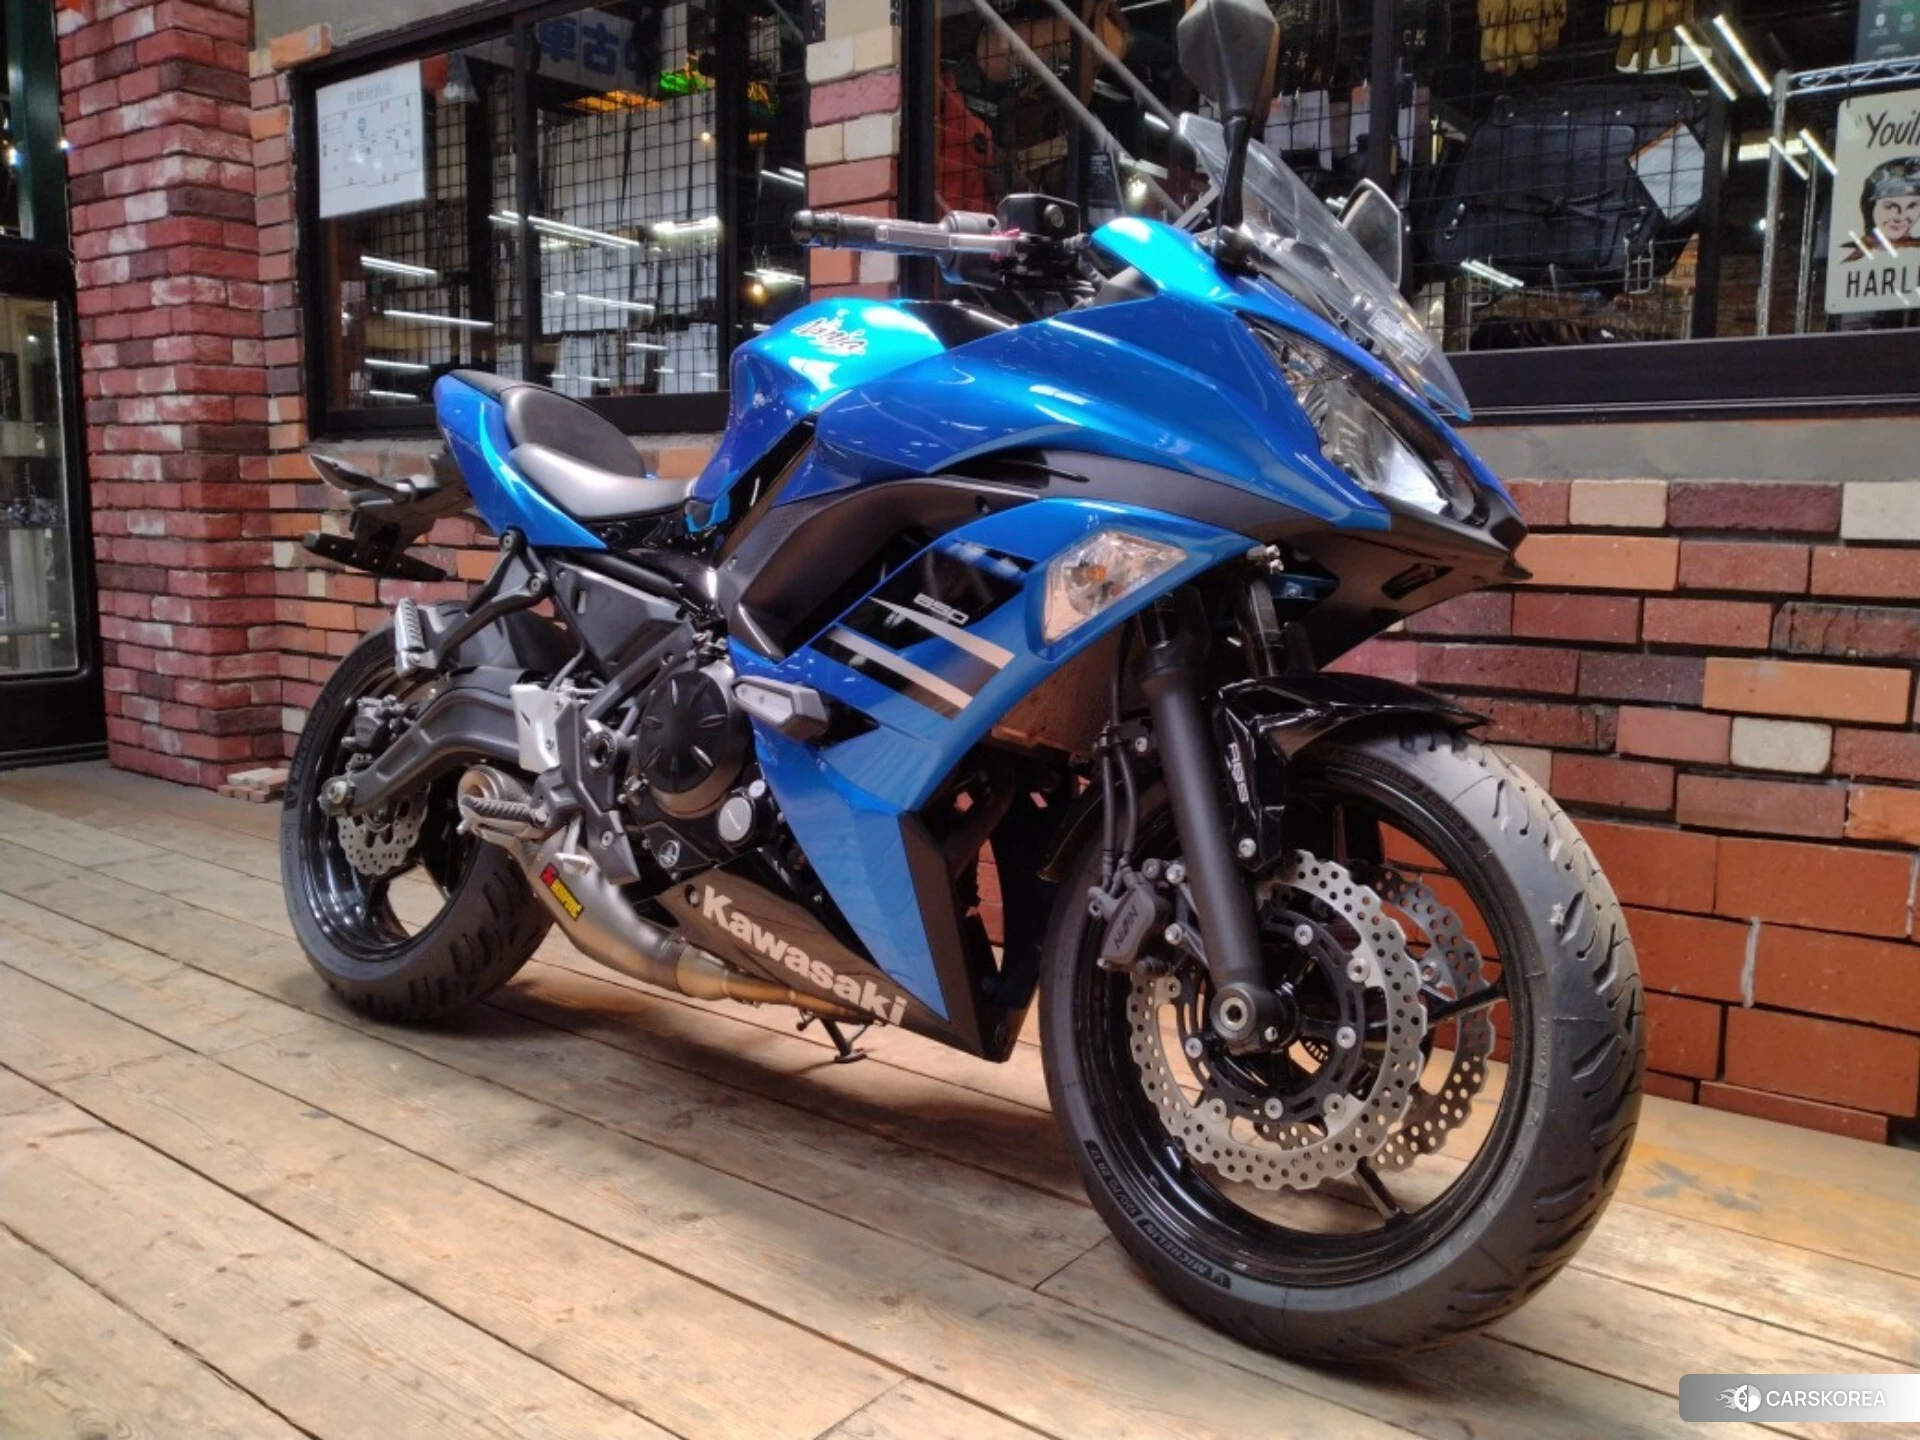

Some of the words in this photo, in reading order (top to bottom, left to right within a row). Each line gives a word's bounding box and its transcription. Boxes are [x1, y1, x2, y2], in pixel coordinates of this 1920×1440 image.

[1846, 265, 1920, 299] HARL
[914, 592, 969, 625] 650
[702, 885, 908, 1026] Kawasaki
[1141, 1222, 1206, 1276] MICHELIN
